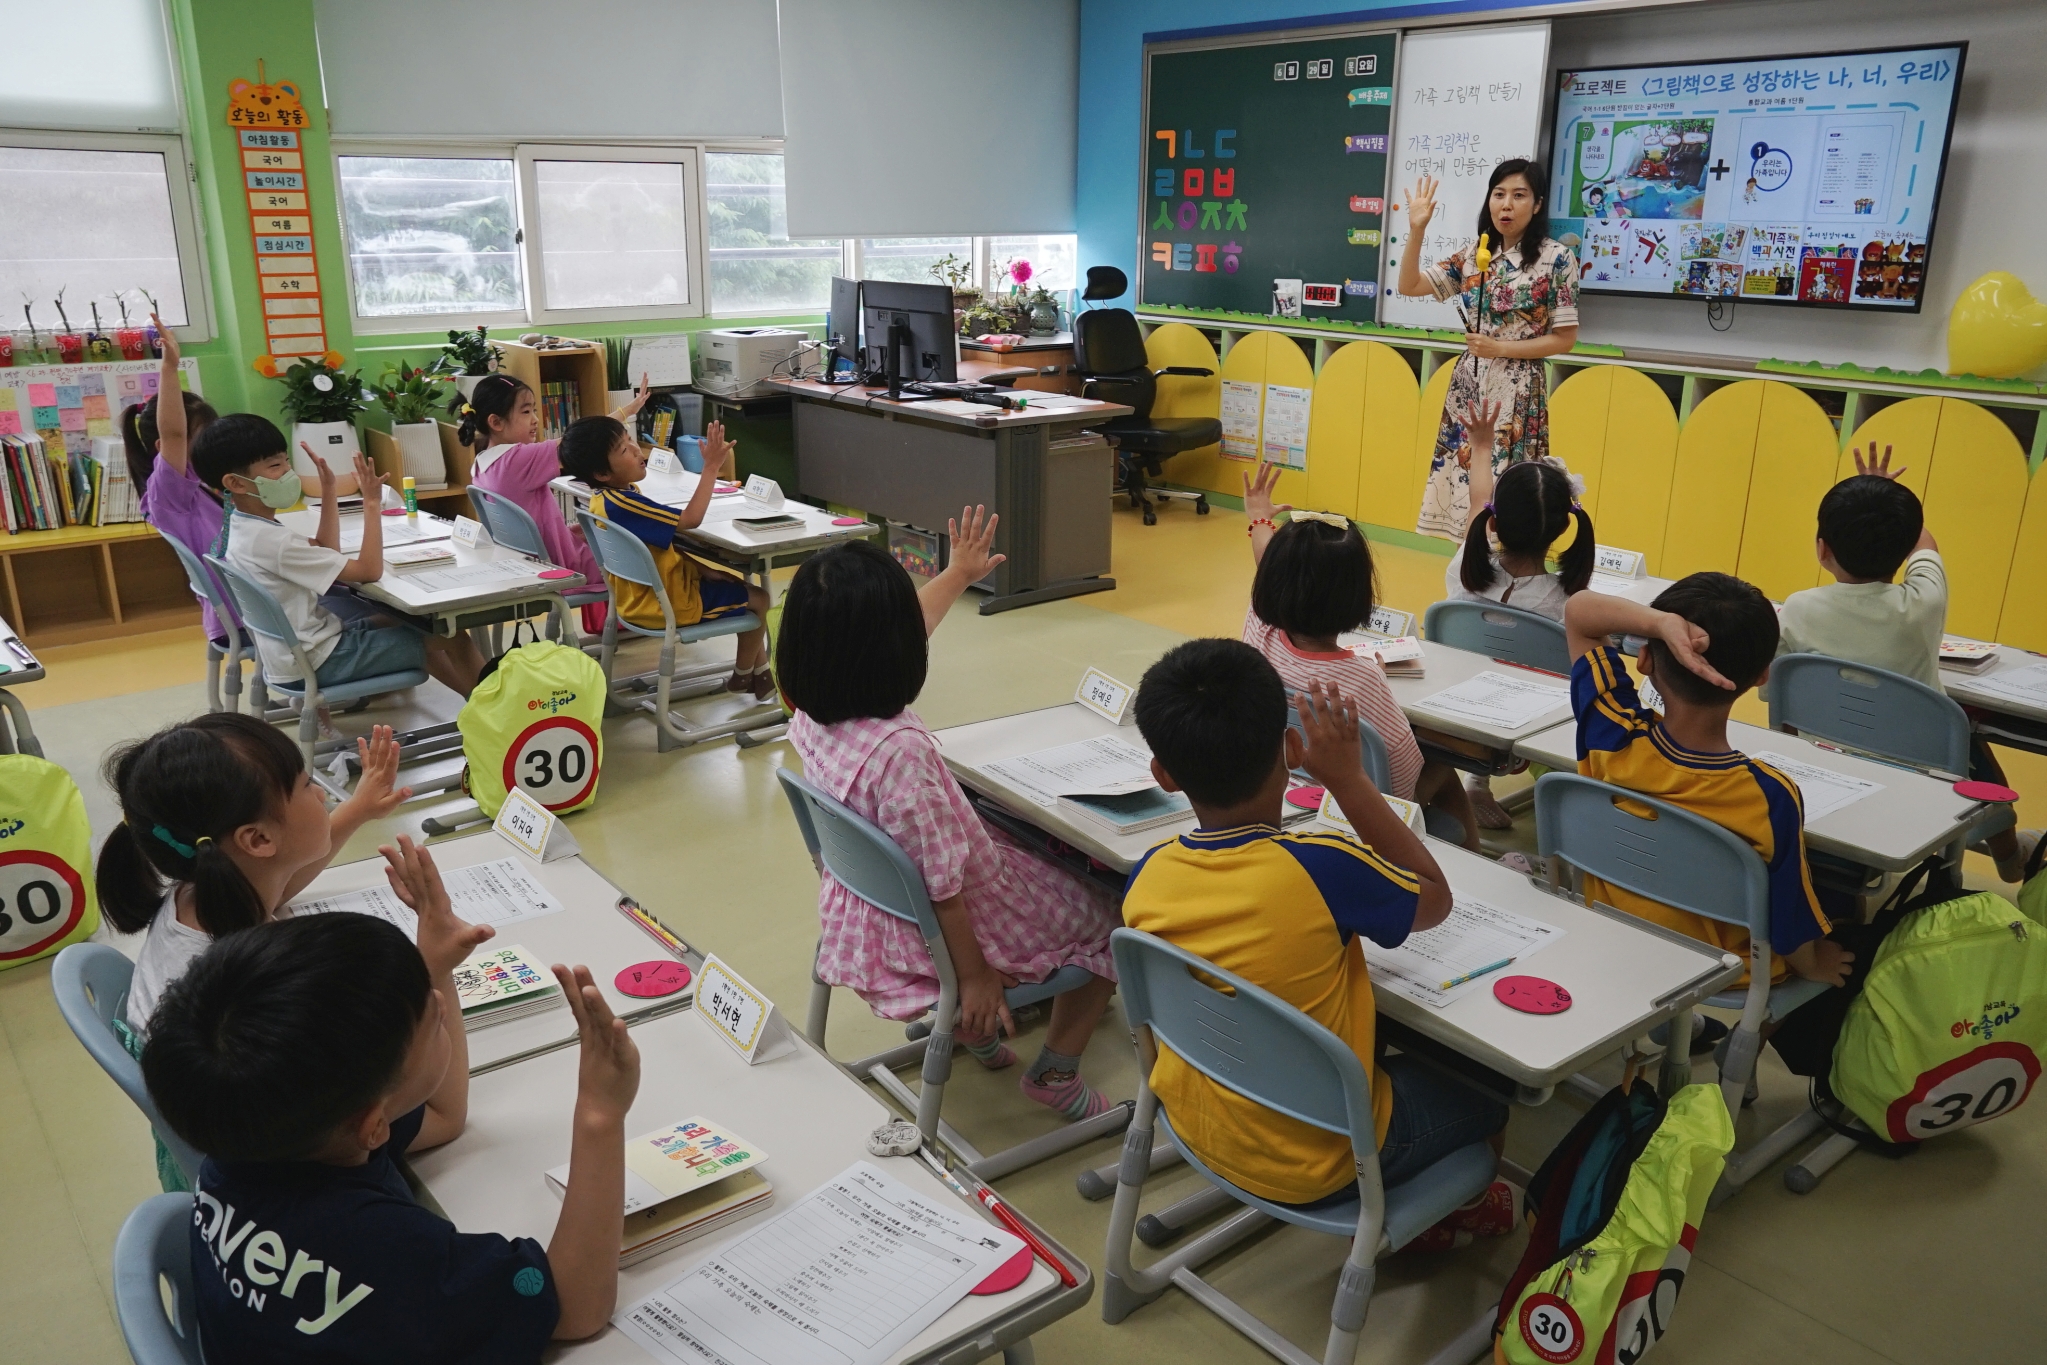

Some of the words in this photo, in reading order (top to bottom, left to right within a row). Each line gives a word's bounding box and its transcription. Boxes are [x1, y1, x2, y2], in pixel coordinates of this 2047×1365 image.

[1573, 79, 1627, 96] 프로젝트
[1743, 69, 1820, 93] 성장하는
[1829, 67, 1853, 89] 나,
[1863, 65, 1887, 87] 너,
[1414, 88, 1438, 107] 가족
[1443, 85, 1481, 104] 그림책
[1489, 82, 1522, 102] 만들기
[231, 107, 271, 124] 오늘의
[277, 108, 304, 125] 활동
[247, 134, 290, 146] 아침활동
[1408, 135, 1431, 154] 가족
[1434, 132, 1481, 153] 그림책은
[262, 154, 284, 166] 국어
[1405, 157, 1445, 177] 어떻게
[1454, 157, 1490, 177] 만들수
[1762, 159, 1782, 168] 우리는
[1754, 168, 1788, 177] 가족입니다
[254, 175, 297, 187] 놀이시간
[268, 196, 288, 206] 국어
[271, 219, 292, 230] 여름
[263, 239, 305, 251] 점심시간
[1767, 232, 1787, 245] 가족
[280, 279, 301, 290] 수학
[528, 692, 576, 714] 아이좋아
[524, 744, 586, 788] 30
[495, 951, 520, 964] 우리
[712, 992, 742, 1032] 박서현
[1920, 1077, 2017, 1129] 30
[673, 1122, 712, 1140] 우리
[1534, 1312, 1566, 1344] 30
